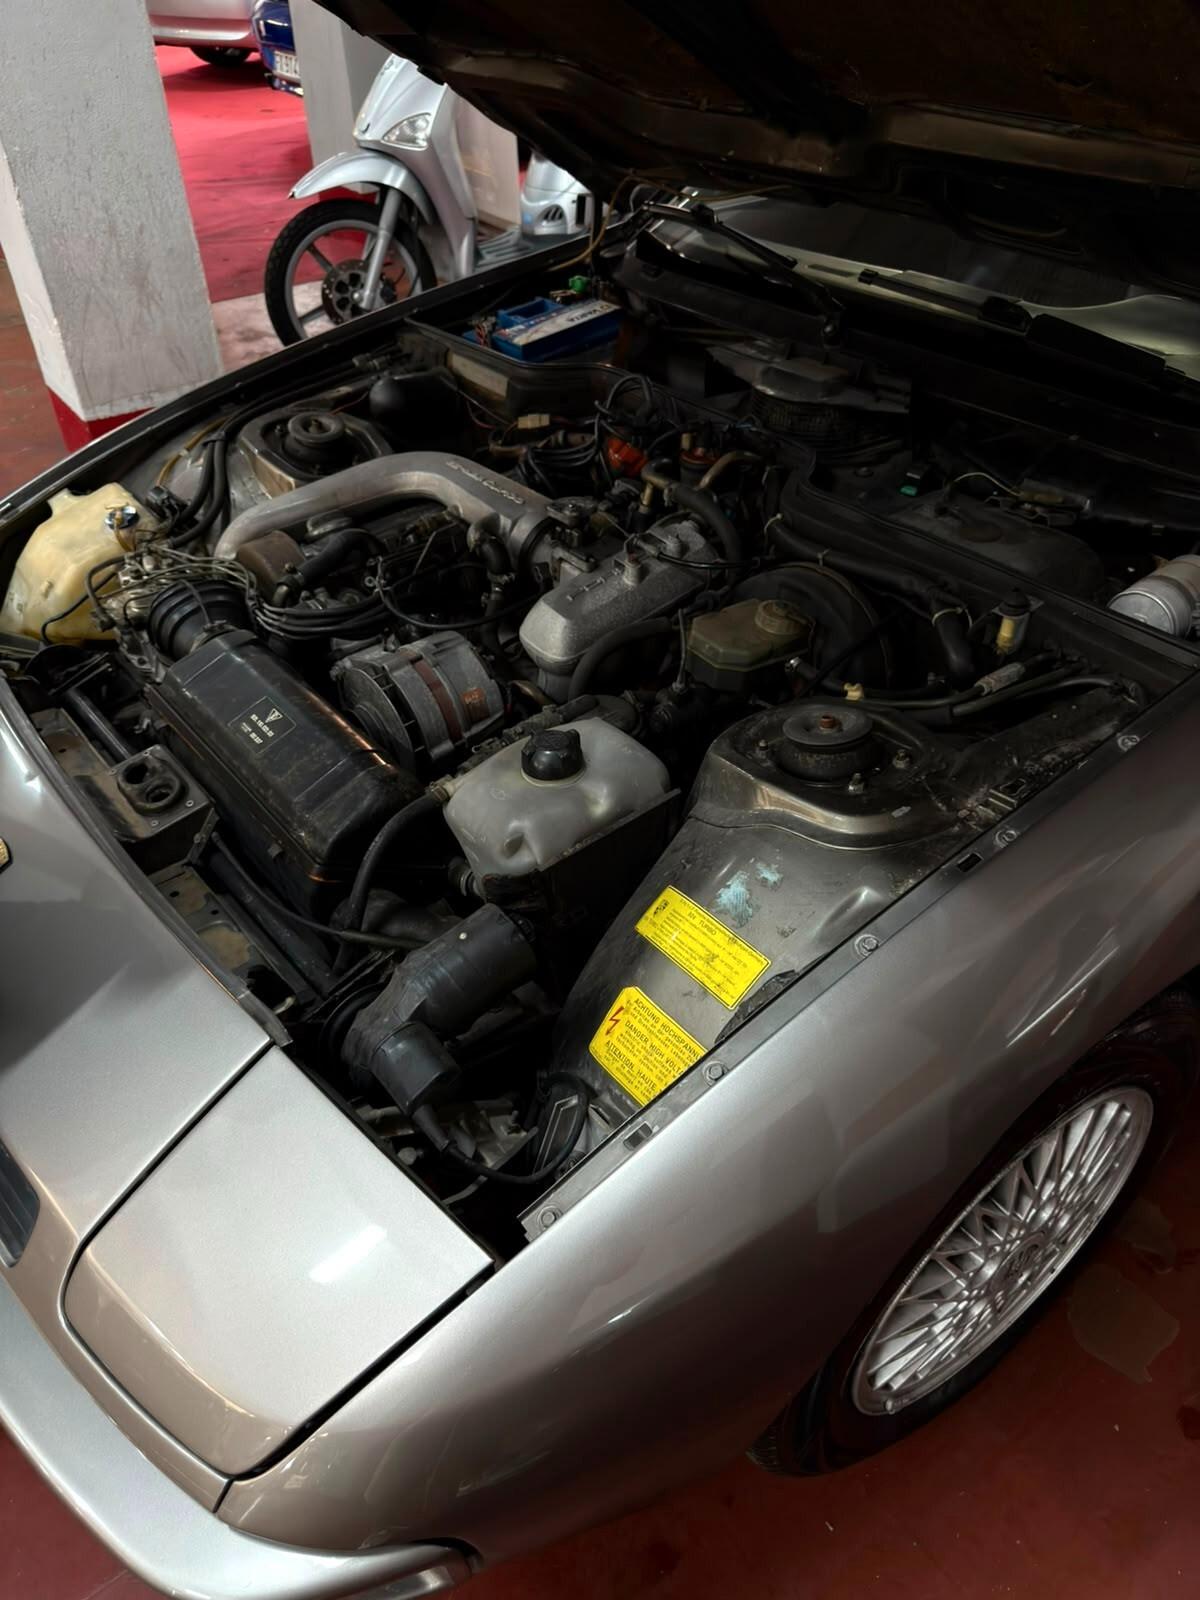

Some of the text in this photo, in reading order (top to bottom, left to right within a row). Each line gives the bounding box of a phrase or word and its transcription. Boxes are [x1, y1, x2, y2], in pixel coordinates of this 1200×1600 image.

[697, 919, 718, 936] TURBO
[632, 997, 662, 1024] ACHTUNG
[623, 1020, 650, 1044] DANGER
[647, 1042, 666, 1059] HIGH
[635, 1069, 658, 1091] HAUTE
